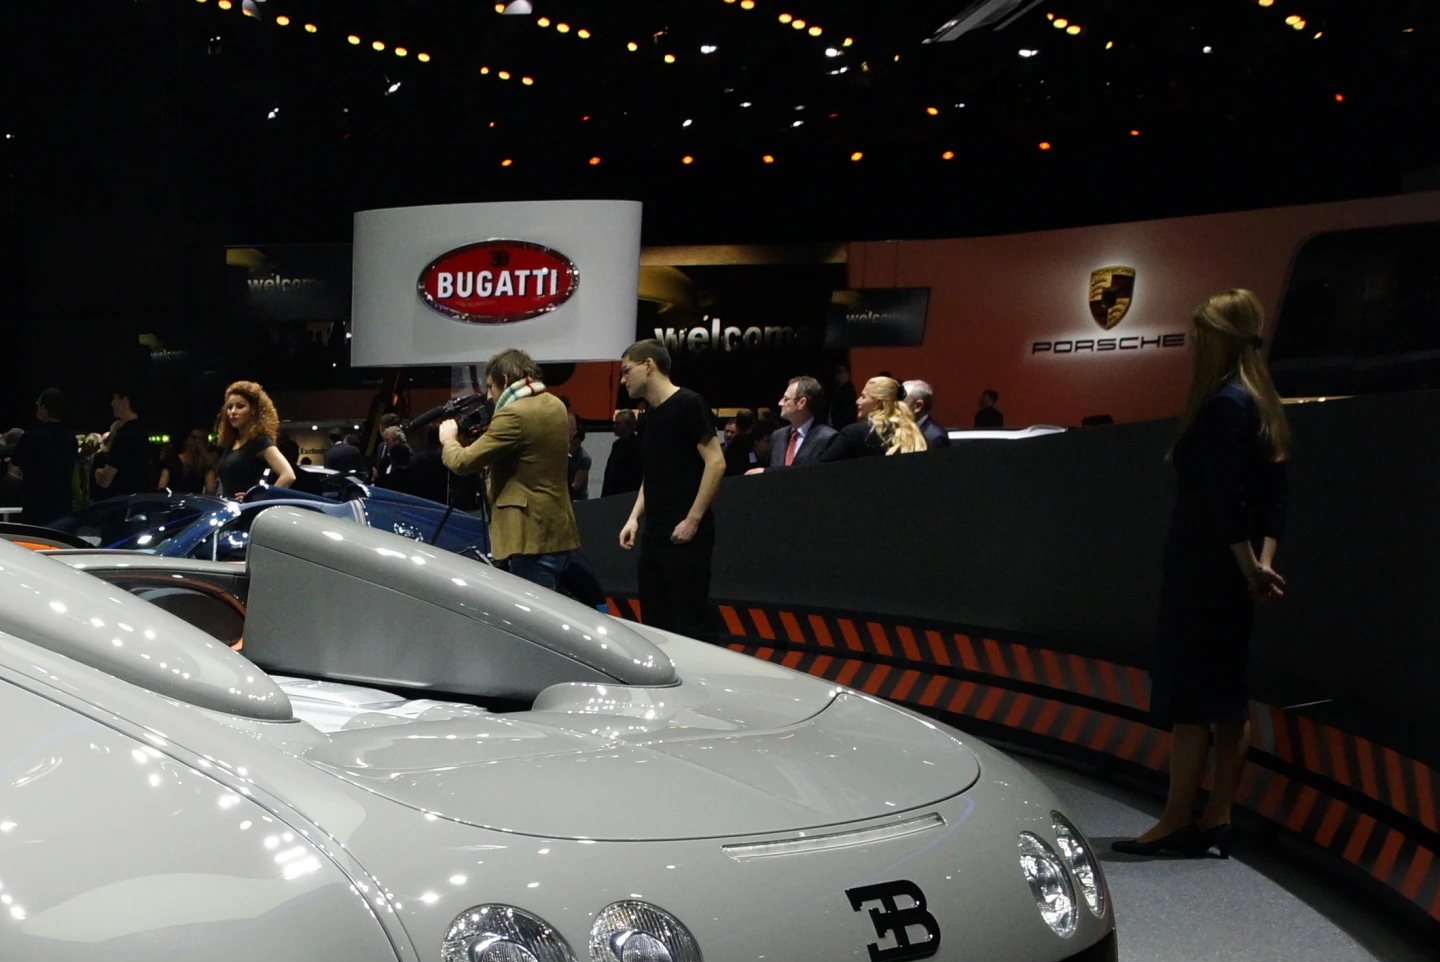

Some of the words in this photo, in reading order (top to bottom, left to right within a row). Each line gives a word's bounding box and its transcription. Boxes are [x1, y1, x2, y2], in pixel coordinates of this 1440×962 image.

[247, 273, 325, 292] welcom
[437, 269, 558, 298] BUGATTI
[653, 316, 810, 352] welcom
[1032, 333, 1186, 355] PORSCHE
